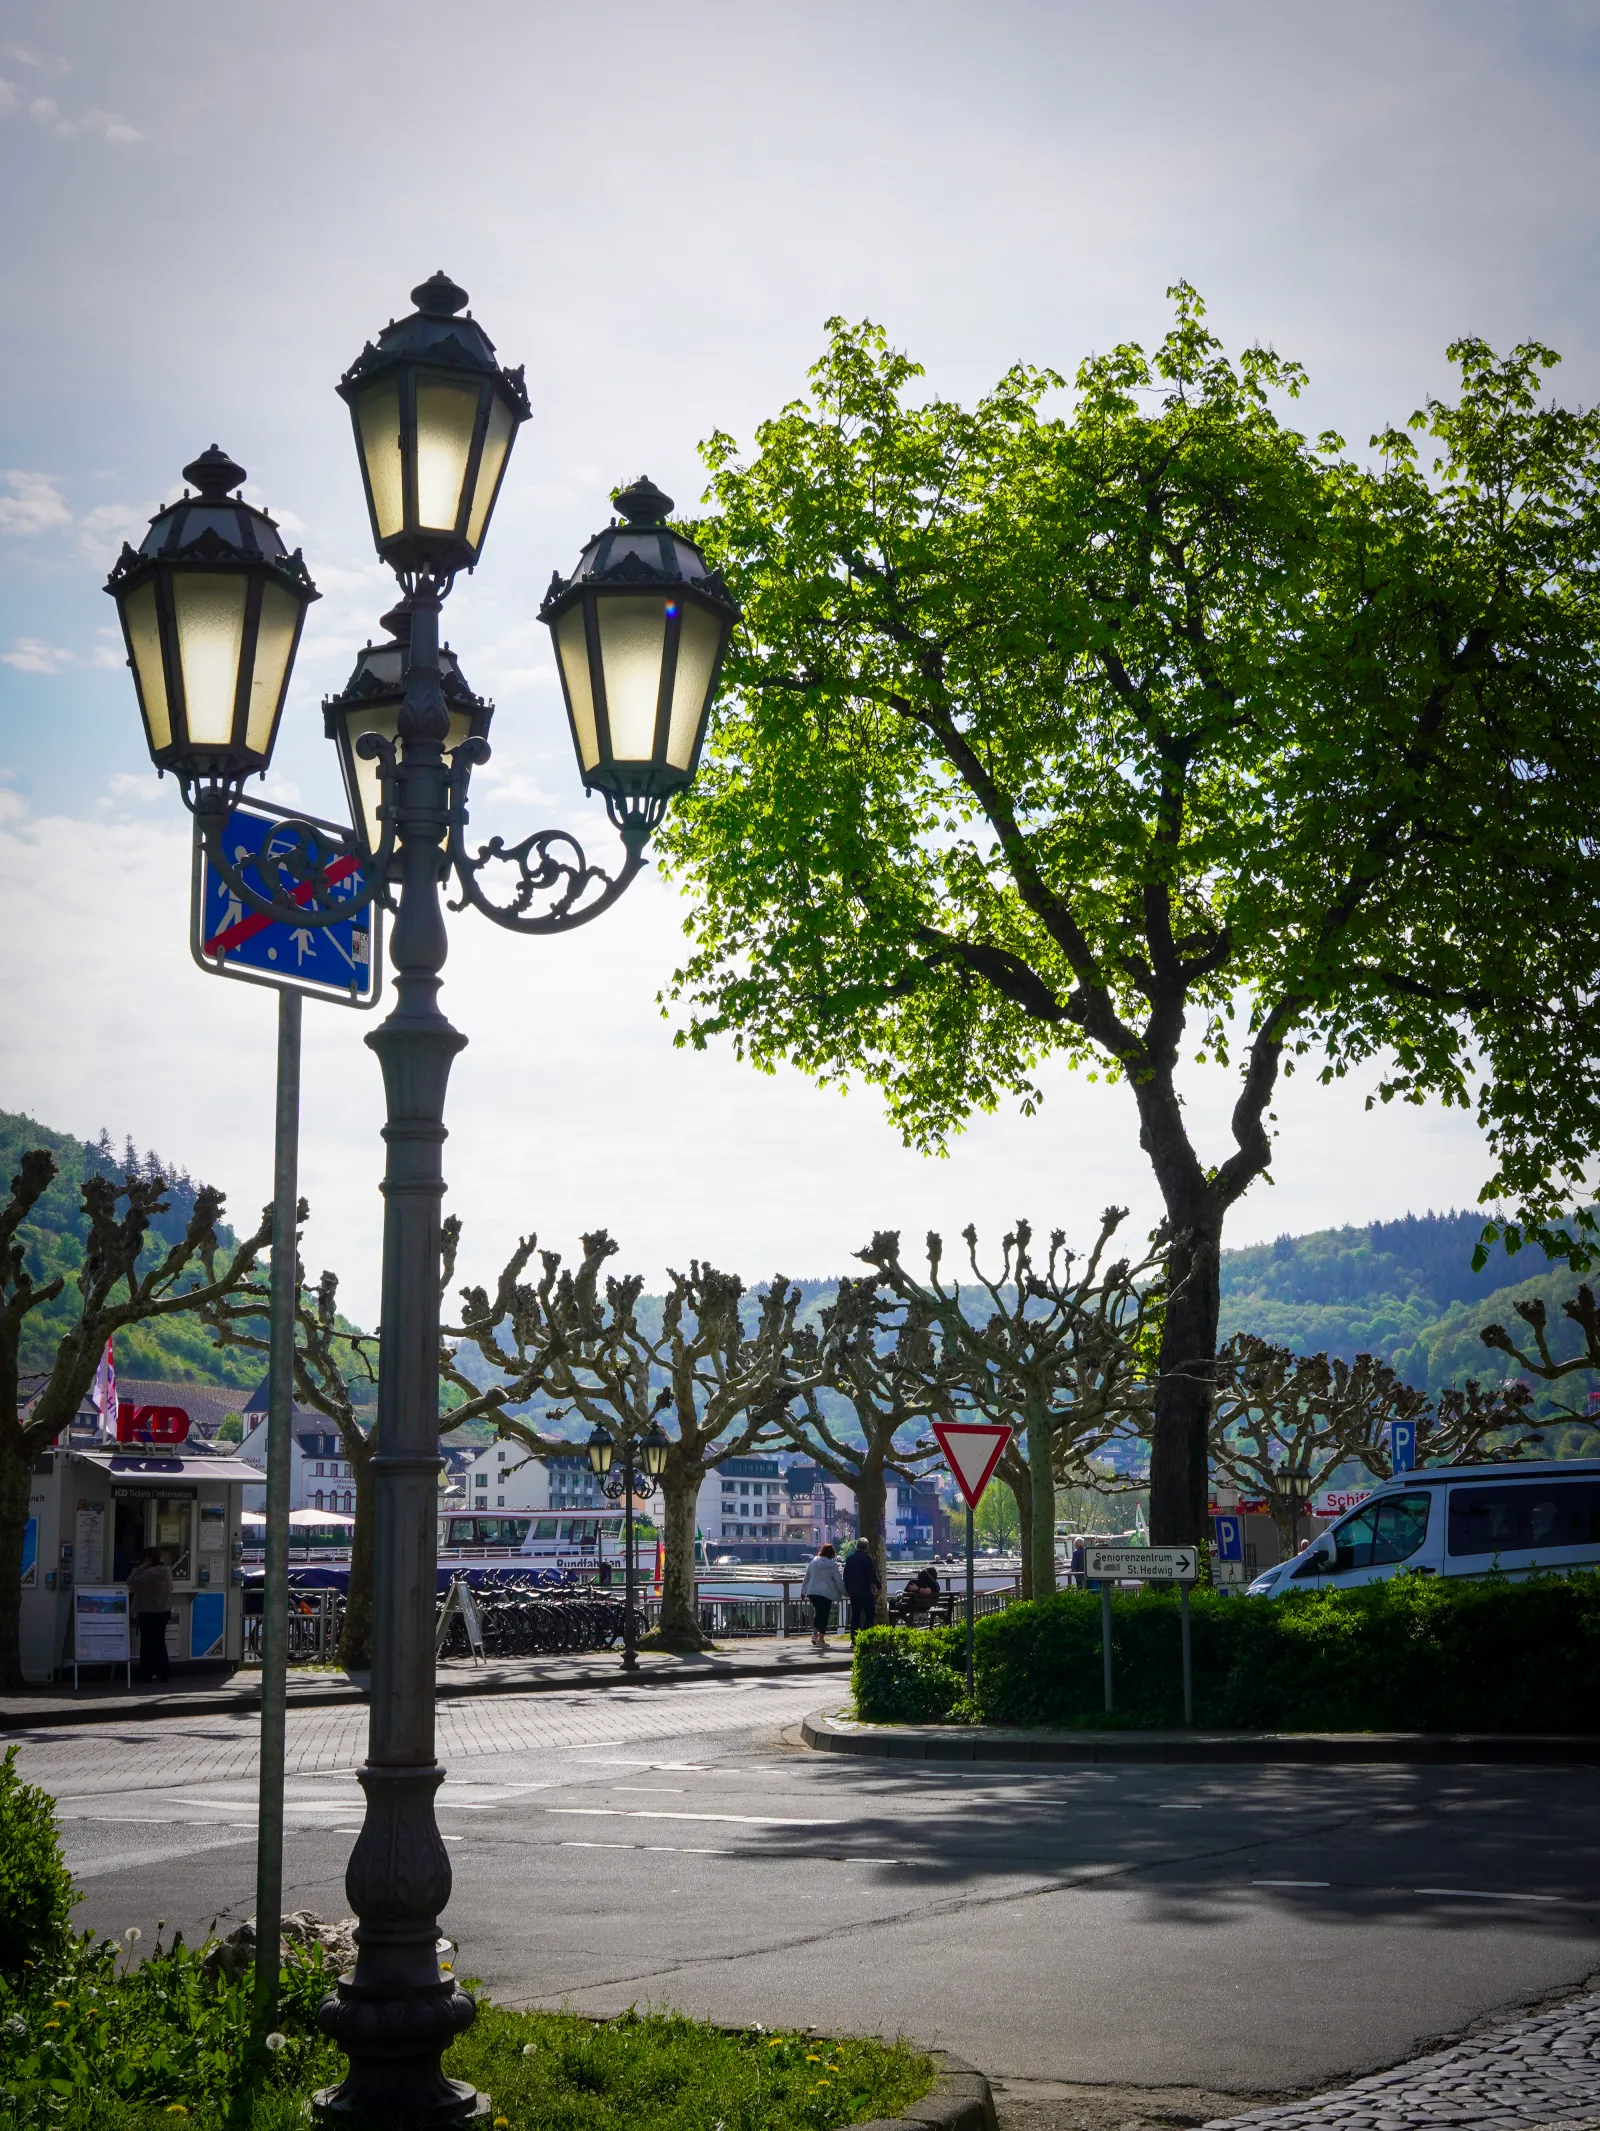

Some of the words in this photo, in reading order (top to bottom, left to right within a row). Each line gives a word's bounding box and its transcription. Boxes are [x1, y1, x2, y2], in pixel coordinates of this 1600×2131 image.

[117, 1404, 190, 1443] KD
[1395, 1427, 1410, 1460] P
[114, 1488, 128, 1497] KD
[129, 1489, 151, 1498] Tickets
[155, 1490, 192, 1499] Information
[1220, 1521, 1235, 1556] P
[1095, 1552, 1173, 1562] Seniorenzentrum
[1127, 1565, 1139, 1575] St.
[1141, 1565, 1173, 1576] Hedwig
